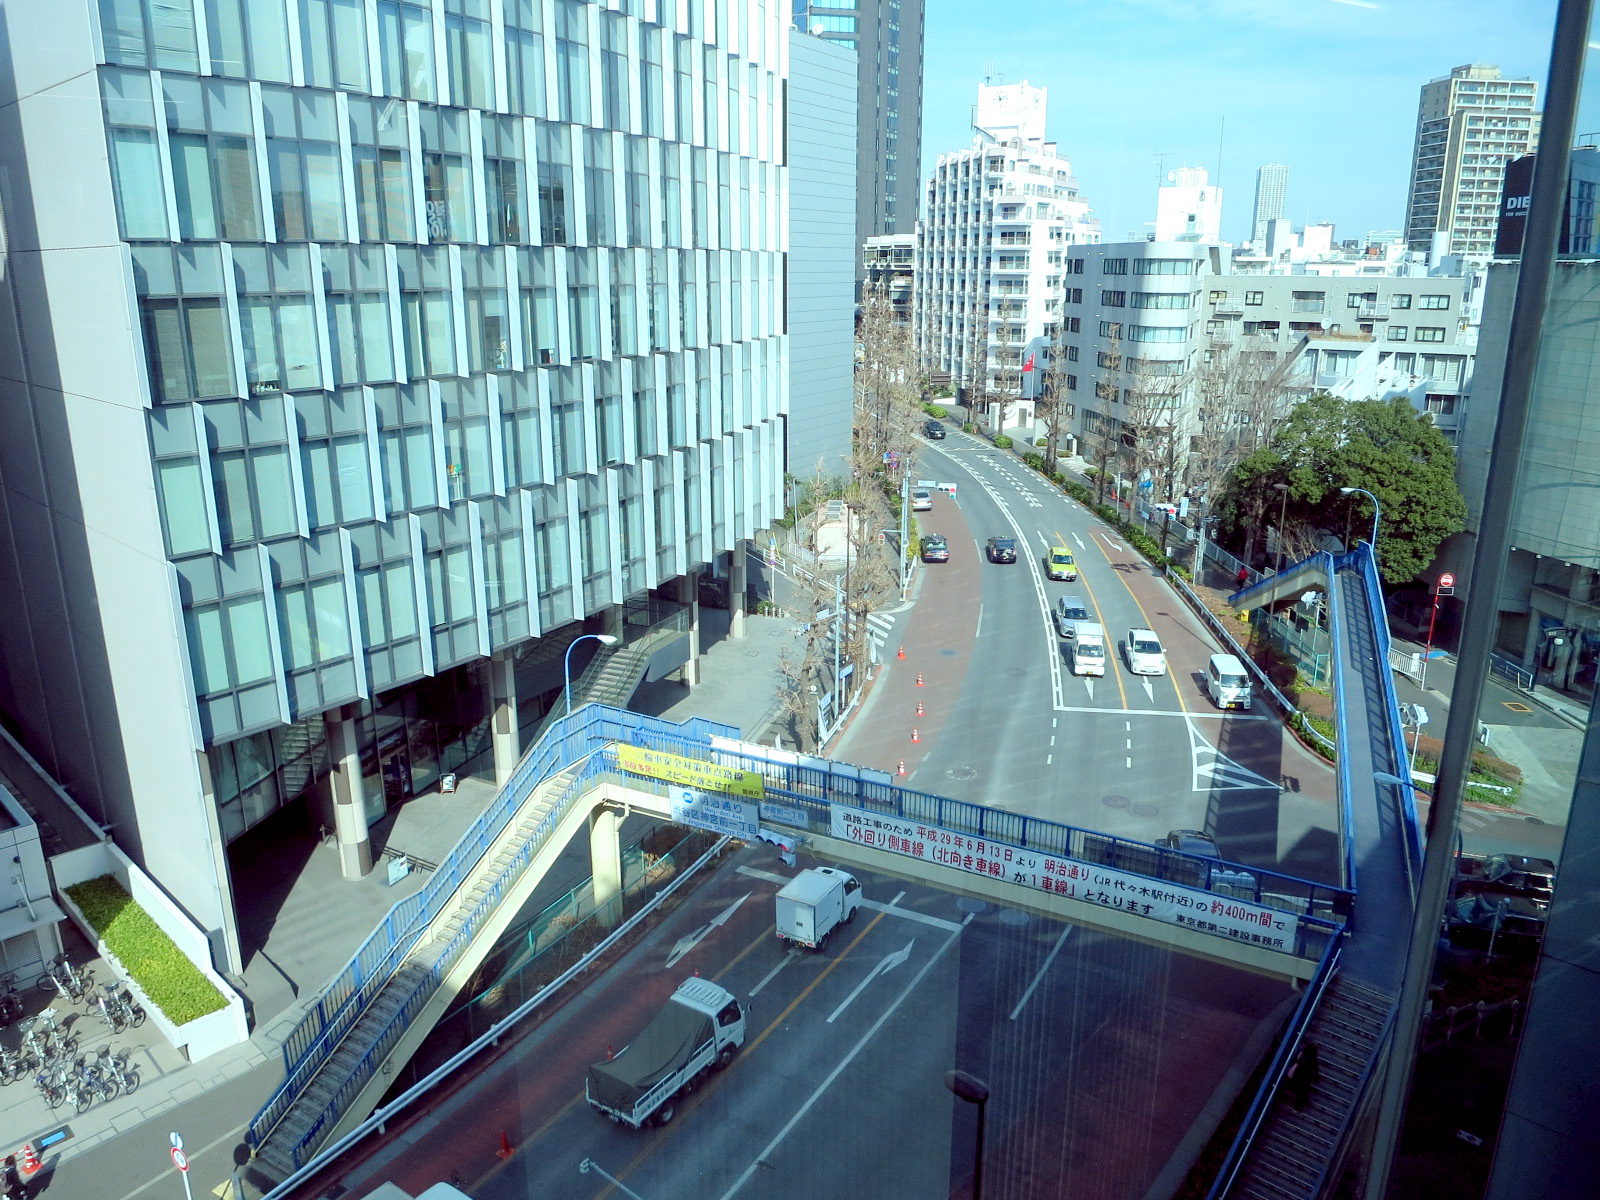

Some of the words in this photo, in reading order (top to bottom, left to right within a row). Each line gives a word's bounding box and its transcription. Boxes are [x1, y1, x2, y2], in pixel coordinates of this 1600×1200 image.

[700, 795, 742, 813] 明治通り
[1176, 914, 1285, 949] 東京都第二建設事務所
